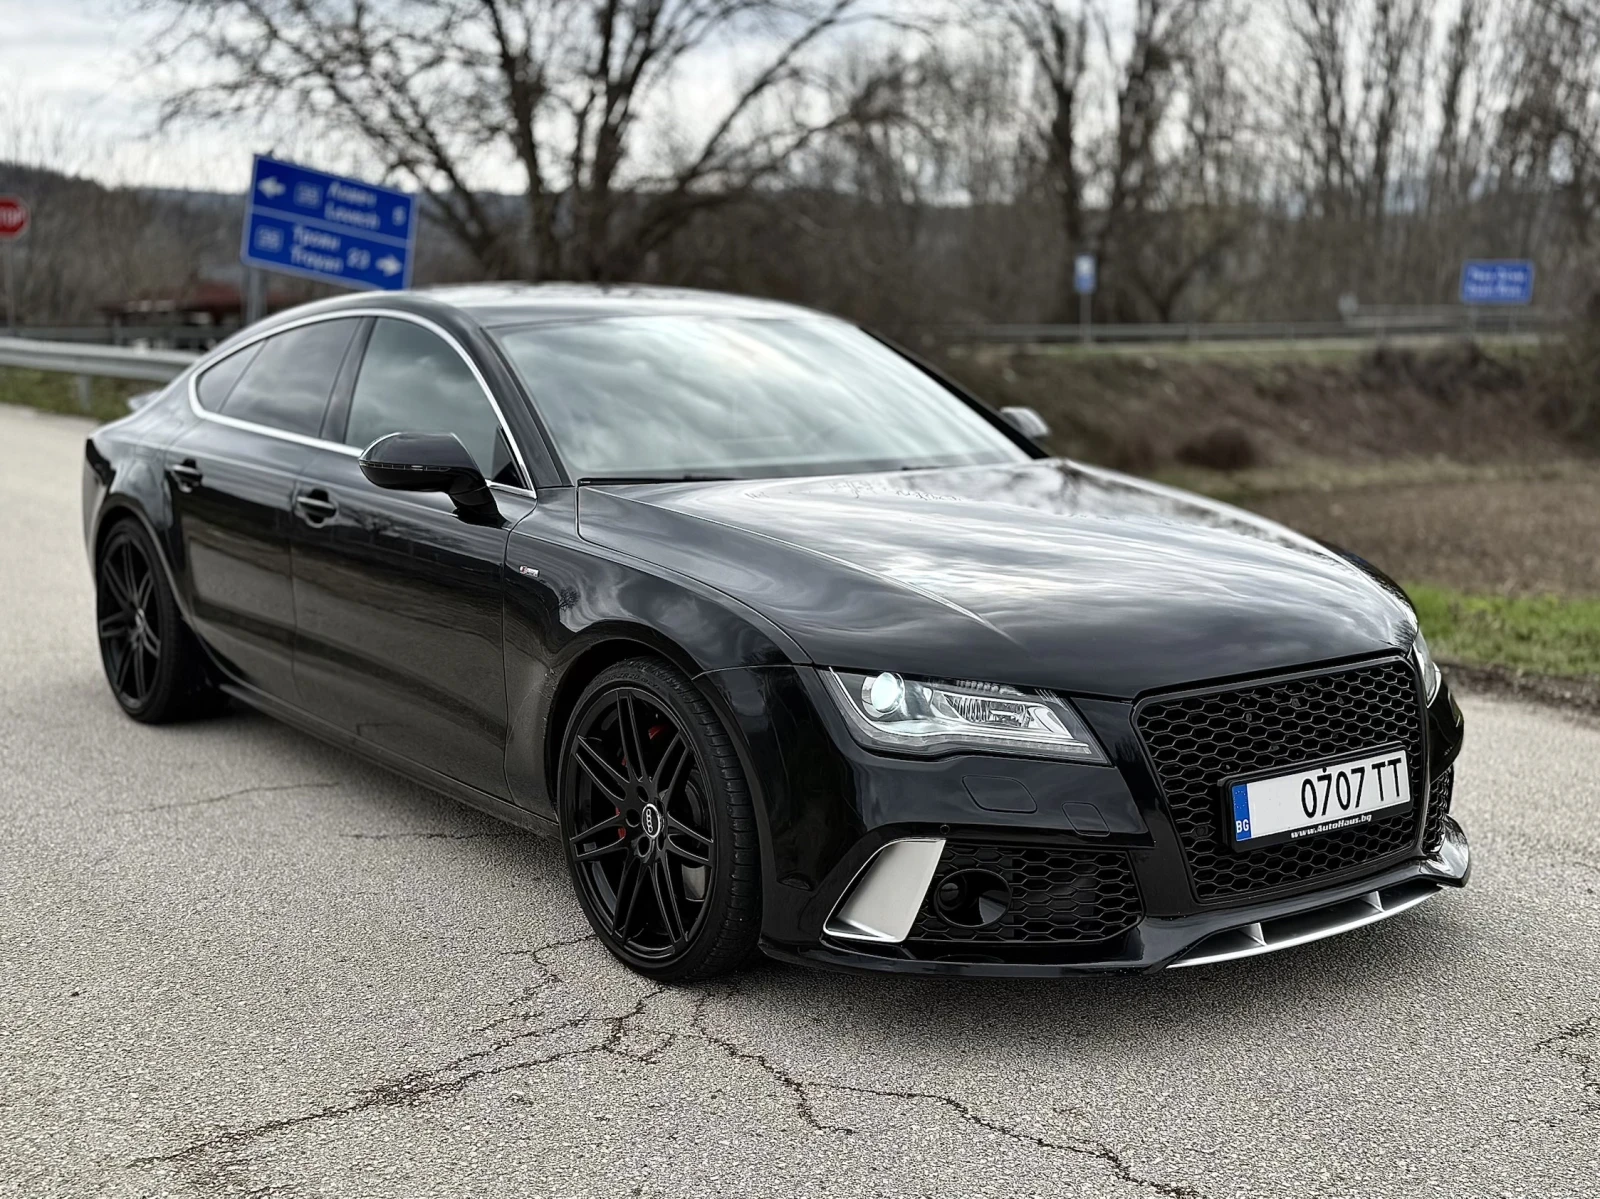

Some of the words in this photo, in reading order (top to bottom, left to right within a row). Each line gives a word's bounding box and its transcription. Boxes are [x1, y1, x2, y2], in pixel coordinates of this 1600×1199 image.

[0, 206, 22, 227] TOP
[1301, 767, 1365, 818] 0707
[1372, 757, 1402, 801] TT
[1236, 819, 1250, 833] BG
[1290, 813, 1372, 838] www.AutoHaus.bg
